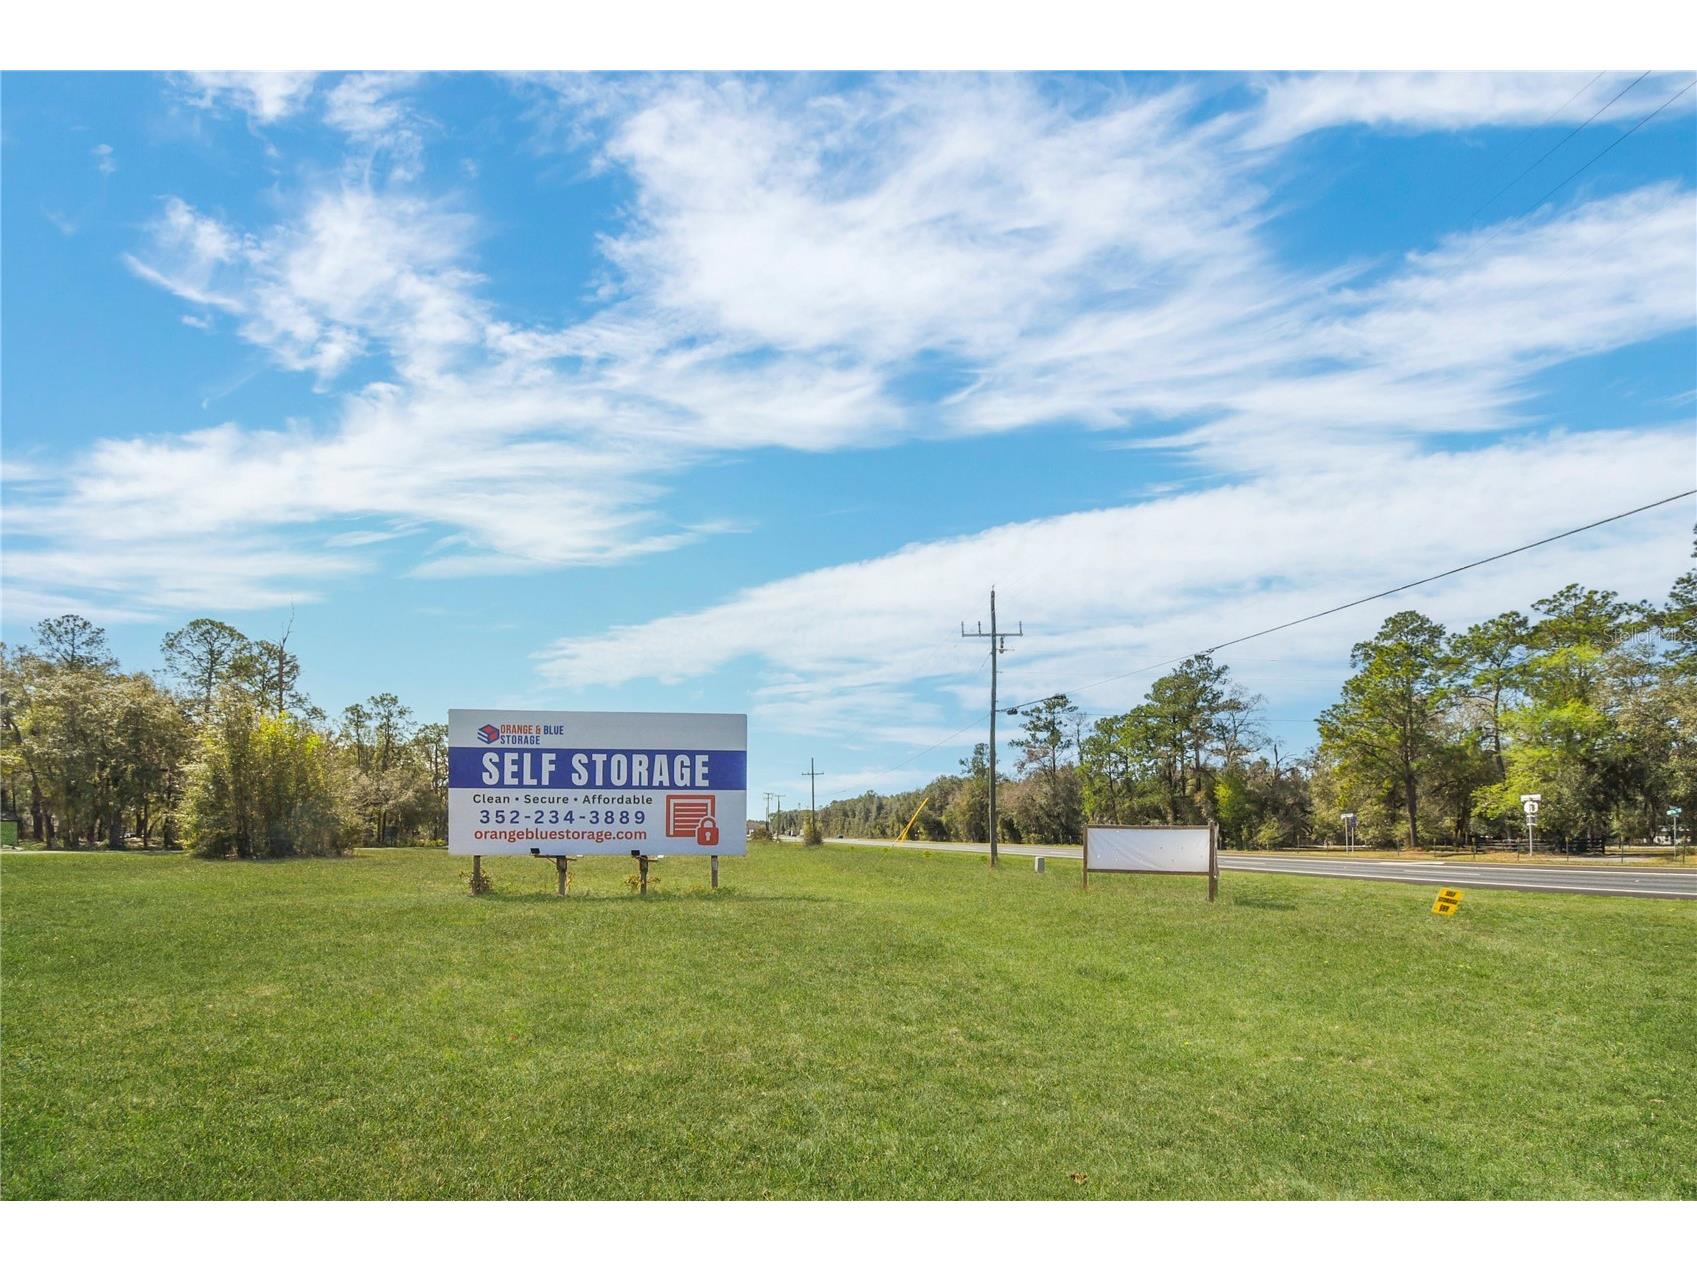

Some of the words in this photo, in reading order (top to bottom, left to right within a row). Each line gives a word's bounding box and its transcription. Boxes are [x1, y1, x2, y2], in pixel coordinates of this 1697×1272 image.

[500, 724, 534, 734] ORANGE
[535, 725, 541, 734] &
[543, 725, 564, 735] BLUE
[500, 735, 540, 745] STORAGE
[482, 752, 556, 785] SELF
[571, 754, 710, 787] STORAGE
[473, 793, 510, 804] Clean
[524, 794, 569, 804] Secure
[582, 794, 653, 805] Affordable
[479, 810, 646, 825] 352-234-3889
[474, 828, 647, 843] orangebluestorage.com
